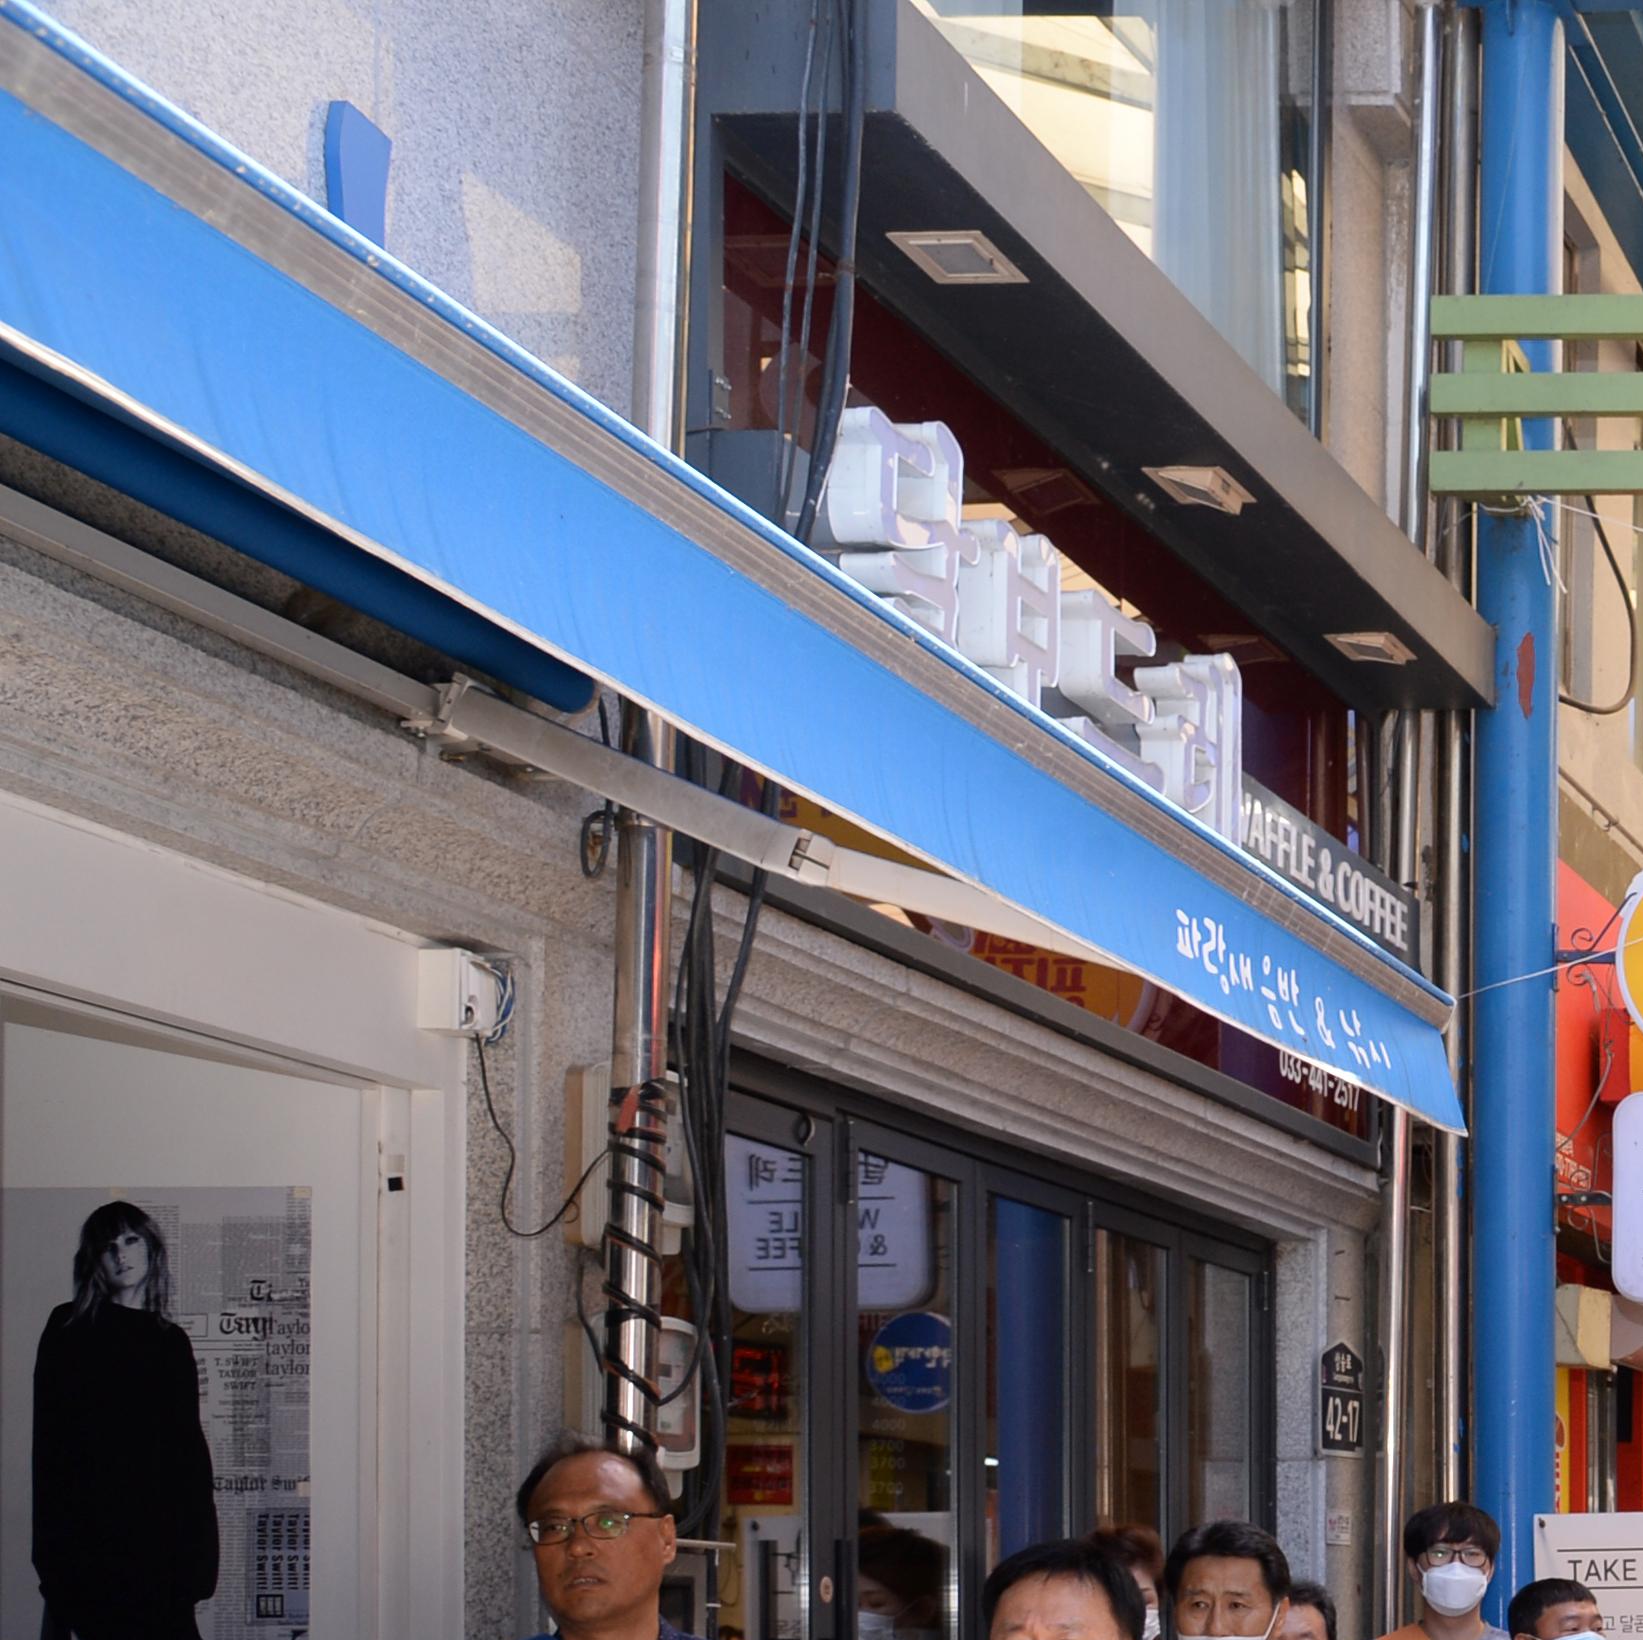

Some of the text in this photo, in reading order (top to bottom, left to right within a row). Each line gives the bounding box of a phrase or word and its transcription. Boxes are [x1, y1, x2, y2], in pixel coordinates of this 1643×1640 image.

[1317, 848, 1336, 903] &
[1337, 860, 1409, 952] COFFEE
[1176, 908, 1392, 1069] 파랑새 음반 & 낚시
[1326, 1396, 1361, 1442] 42-17
[1568, 1559, 1637, 1582] TAKE
